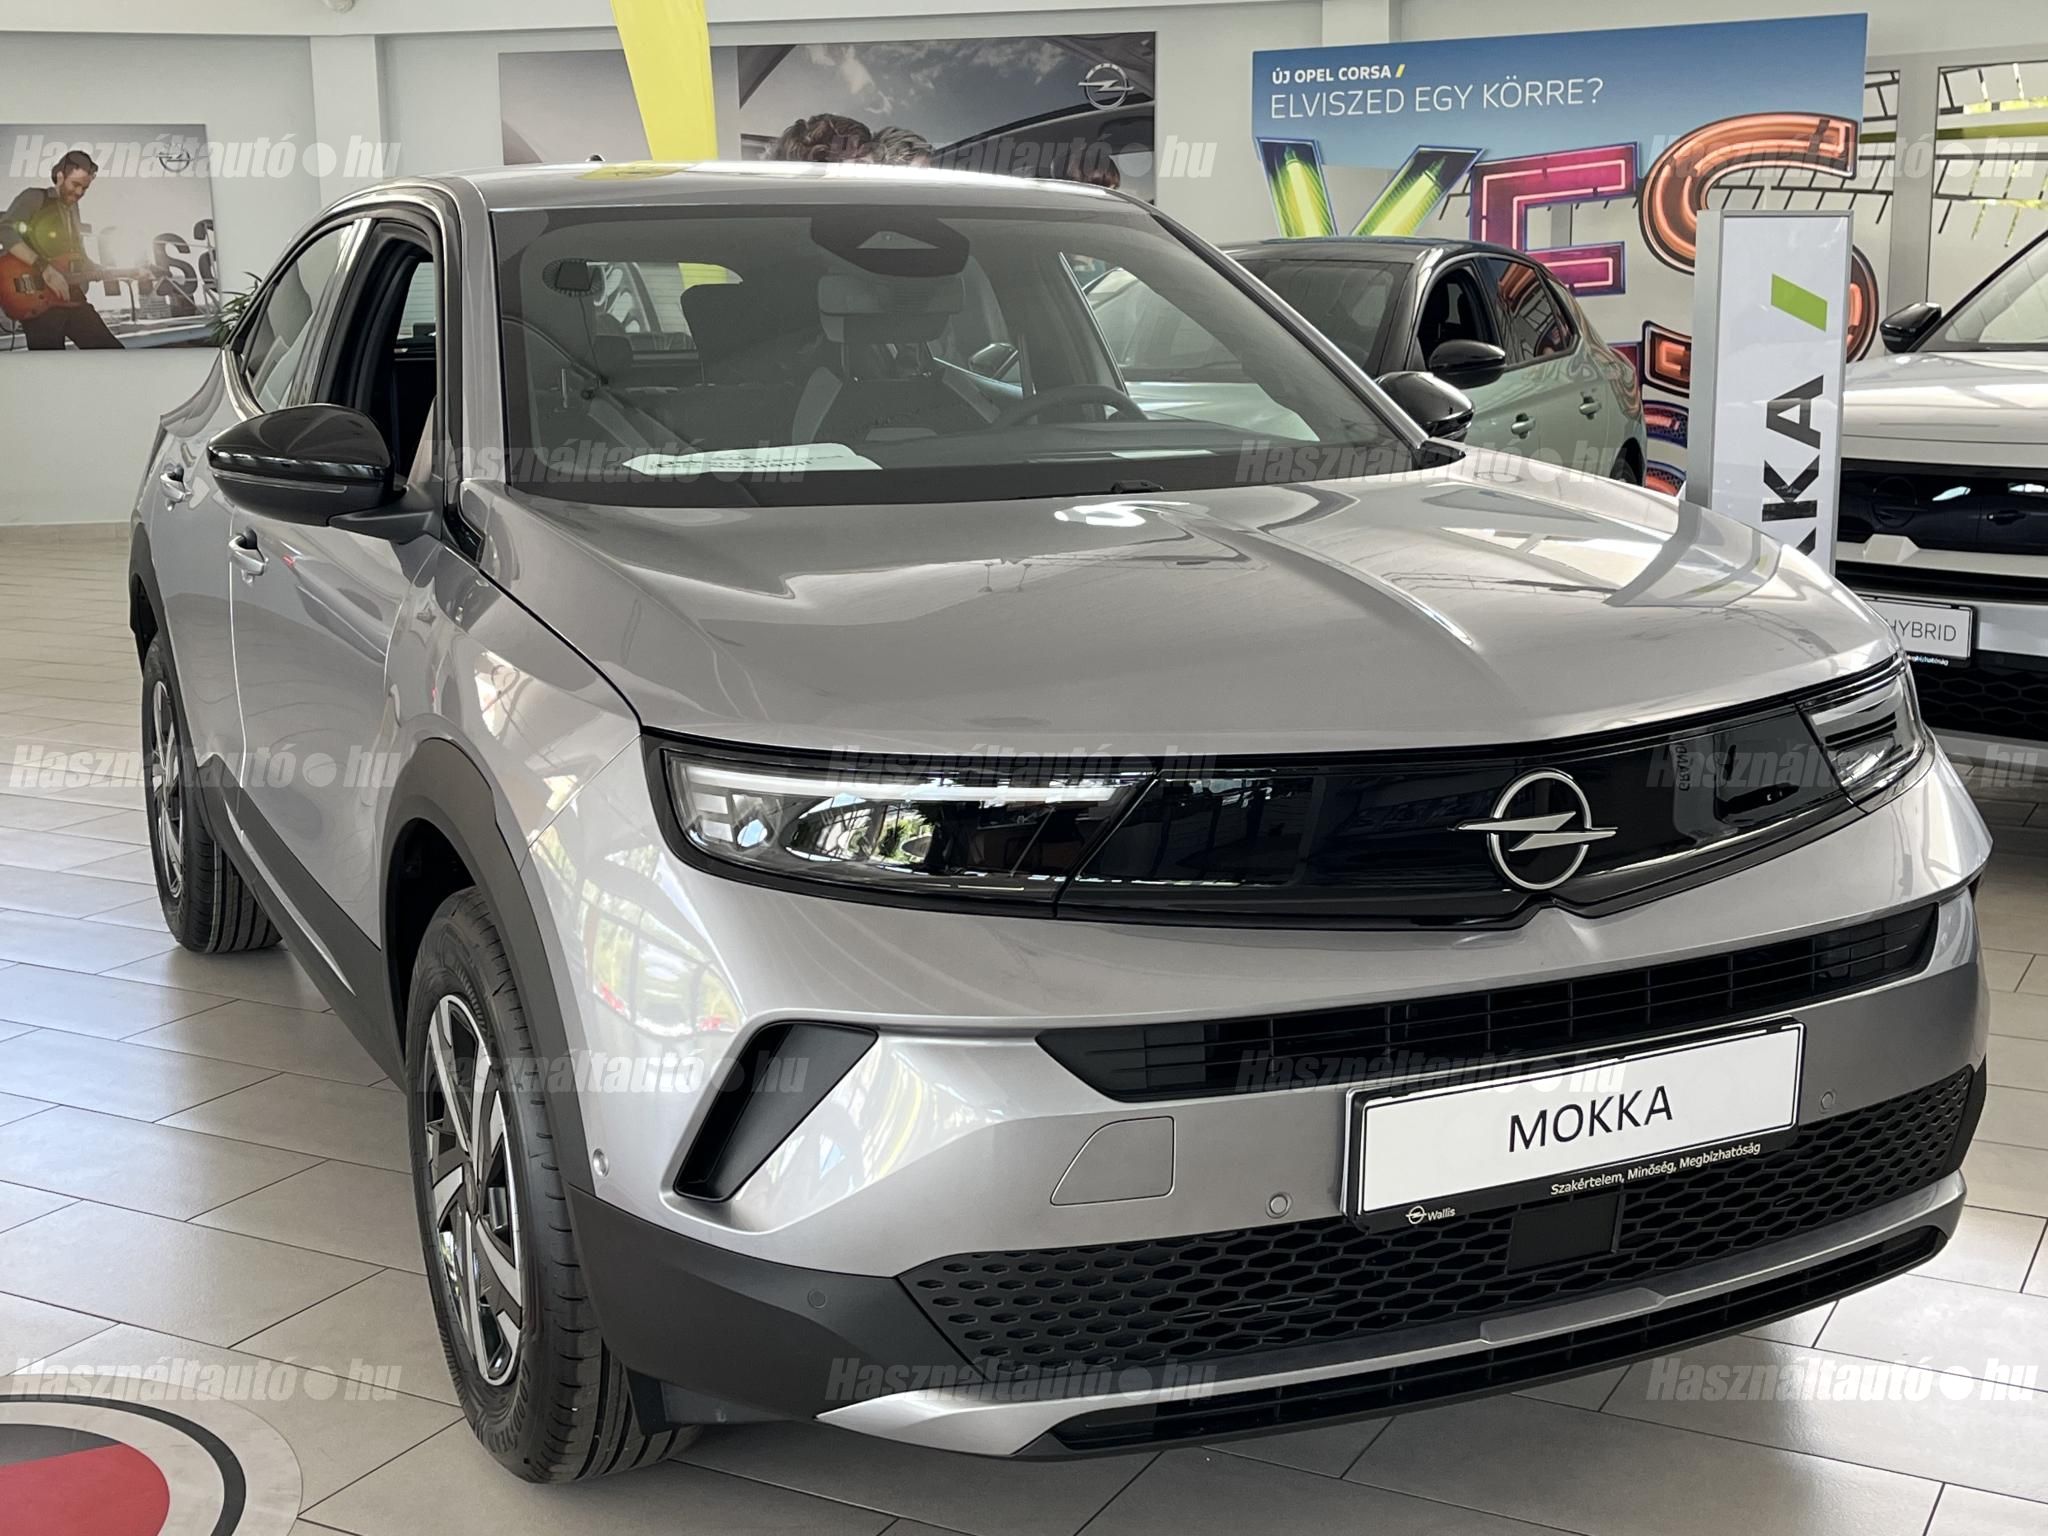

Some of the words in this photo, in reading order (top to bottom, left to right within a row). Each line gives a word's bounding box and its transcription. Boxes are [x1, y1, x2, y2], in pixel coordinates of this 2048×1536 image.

[1272, 67, 1290, 84] ÚJ
[1294, 68, 1334, 83] OPEL
[1338, 65, 1391, 80] CORSA
[1271, 88, 1404, 119] ELVISZED
[1415, 84, 1473, 112] EGY
[1483, 75, 1603, 109] KÖRRE?
[1762, 375, 1824, 556] KA
[1509, 1086, 1673, 1152] MOKKA
[1551, 1172, 1624, 1195] Szakértelem,
[1427, 1207, 1456, 1221] Wallis
